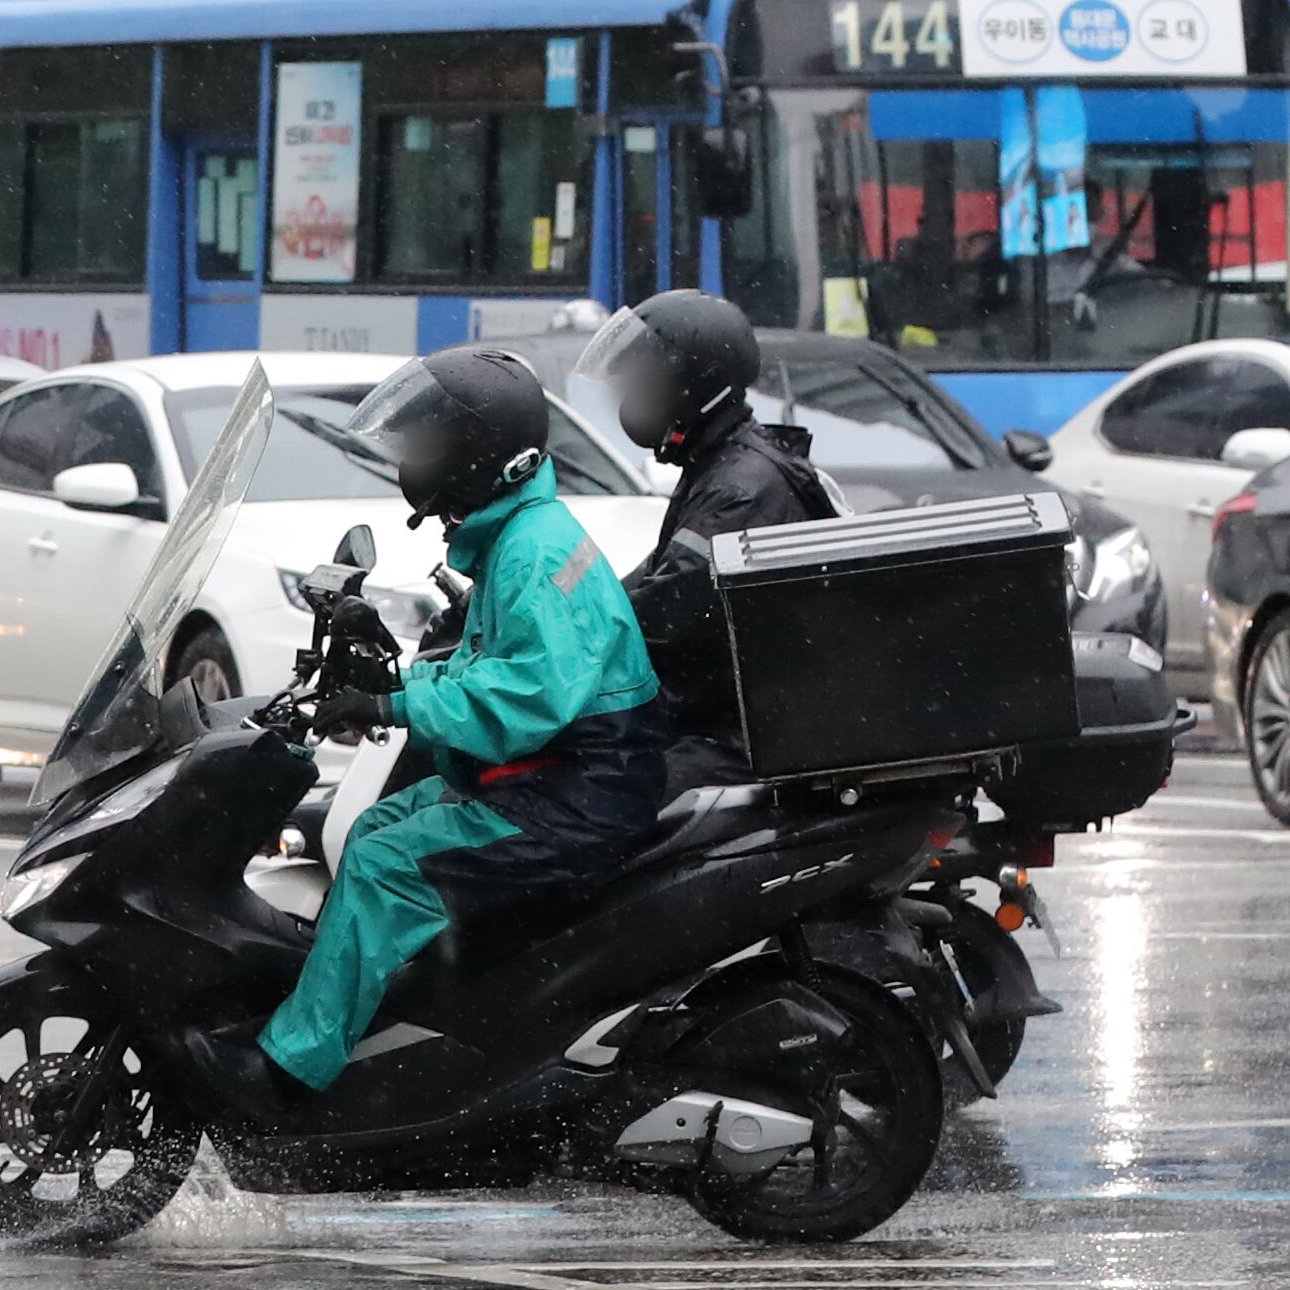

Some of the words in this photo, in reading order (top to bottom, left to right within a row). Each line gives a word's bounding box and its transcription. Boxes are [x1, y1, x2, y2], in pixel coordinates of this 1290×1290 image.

[833, 0, 953, 67] 144
[985, 18, 1046, 42] 우이동
[760, 853, 854, 895] PCX
